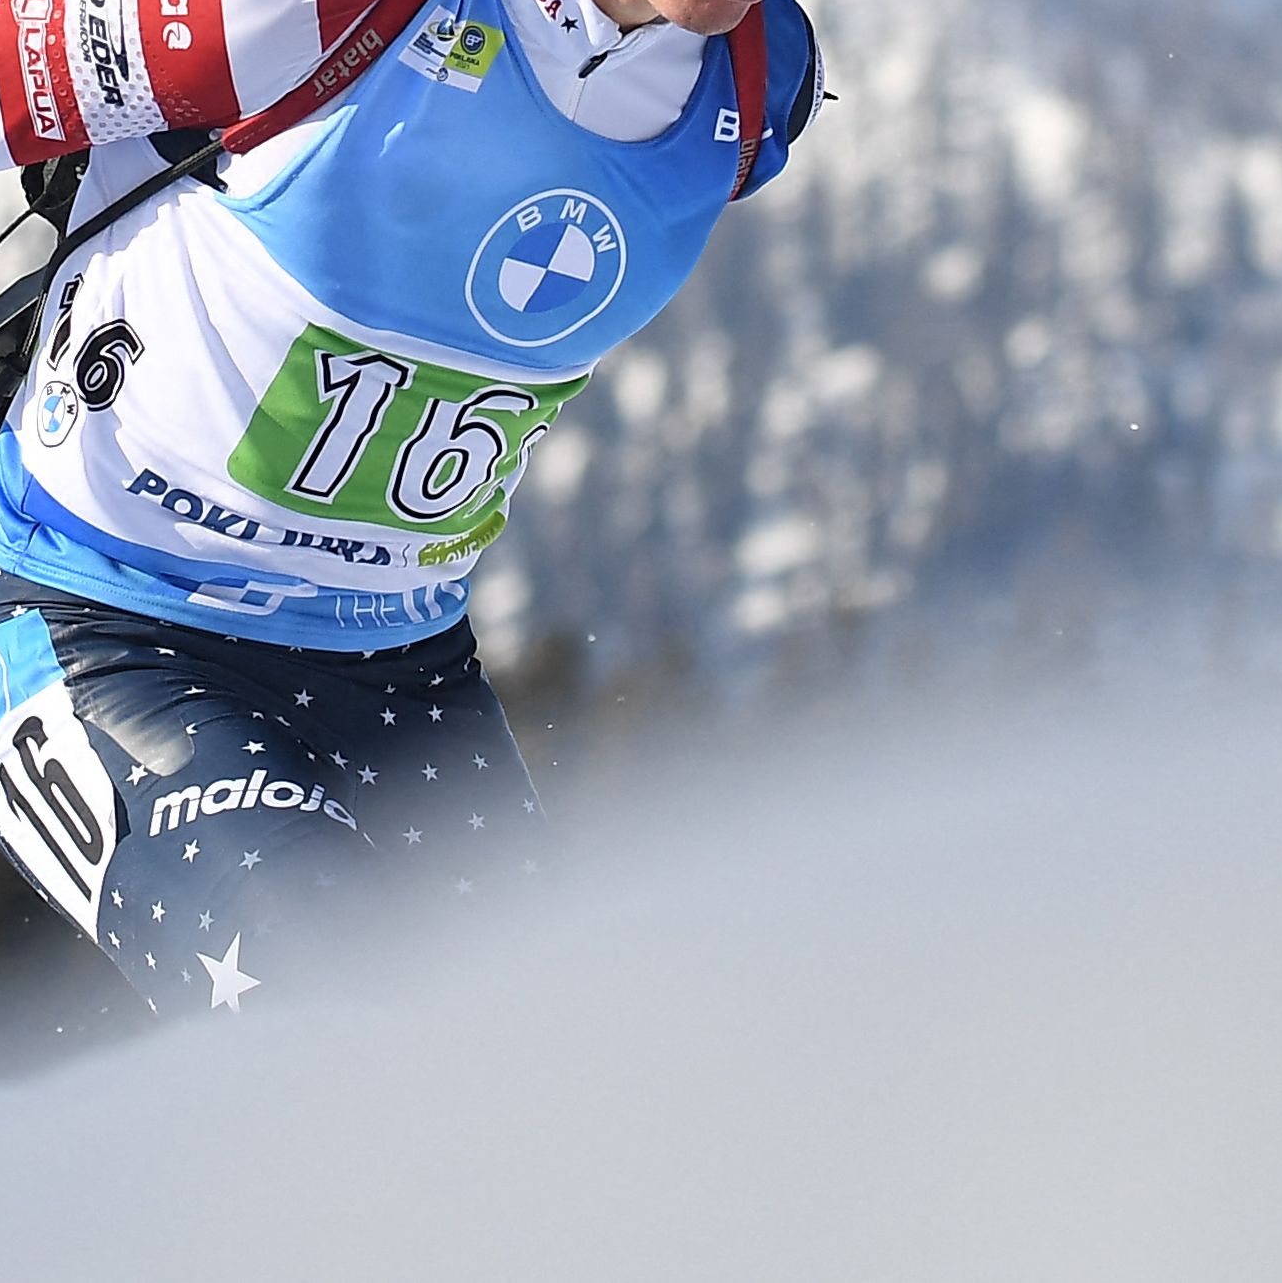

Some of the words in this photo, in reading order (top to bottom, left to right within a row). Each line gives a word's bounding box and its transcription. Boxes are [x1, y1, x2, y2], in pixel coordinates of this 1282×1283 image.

[24, 28, 56, 134] LAPUA
[88, 14, 125, 108] EDER
[516, 198, 617, 253] BMW
[284, 349, 539, 523] 16
